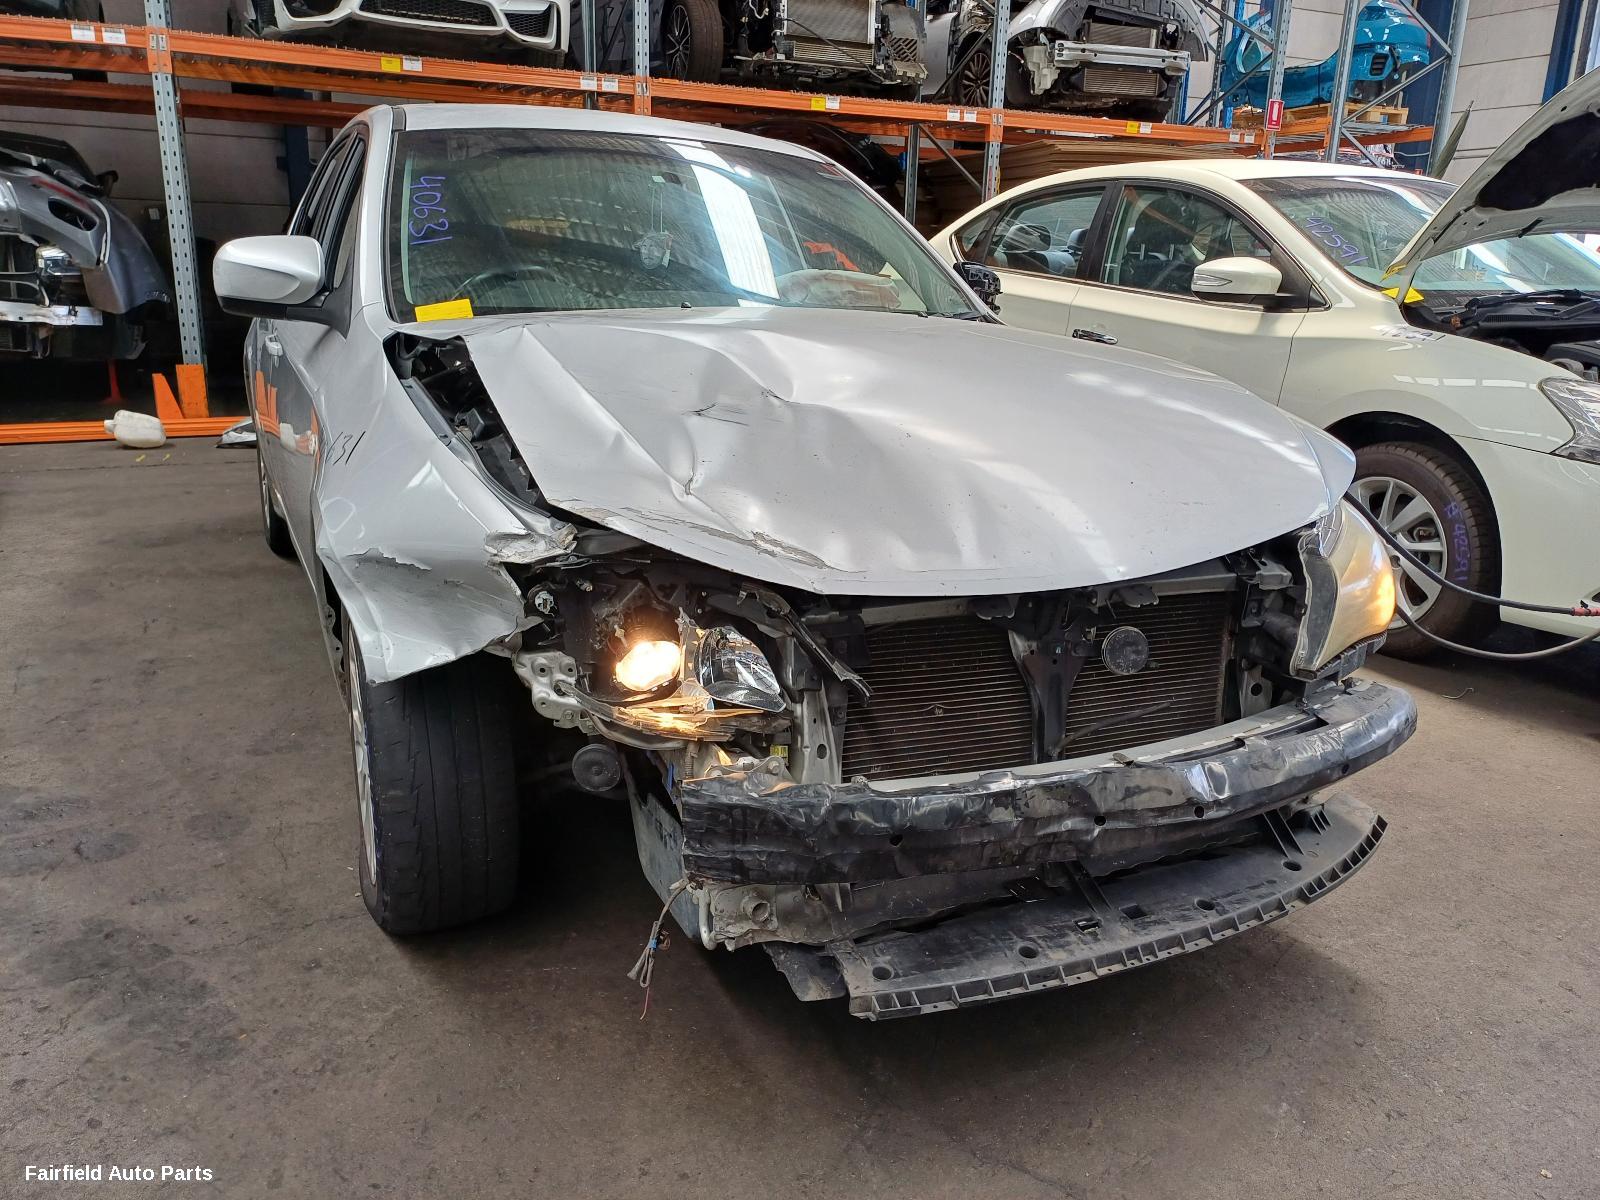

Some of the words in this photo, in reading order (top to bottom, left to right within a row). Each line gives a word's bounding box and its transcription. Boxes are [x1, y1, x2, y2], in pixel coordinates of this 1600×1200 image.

[408, 175, 453, 245] 40631
[1305, 216, 1369, 264] 42591
[1454, 523, 1469, 580] 42591
